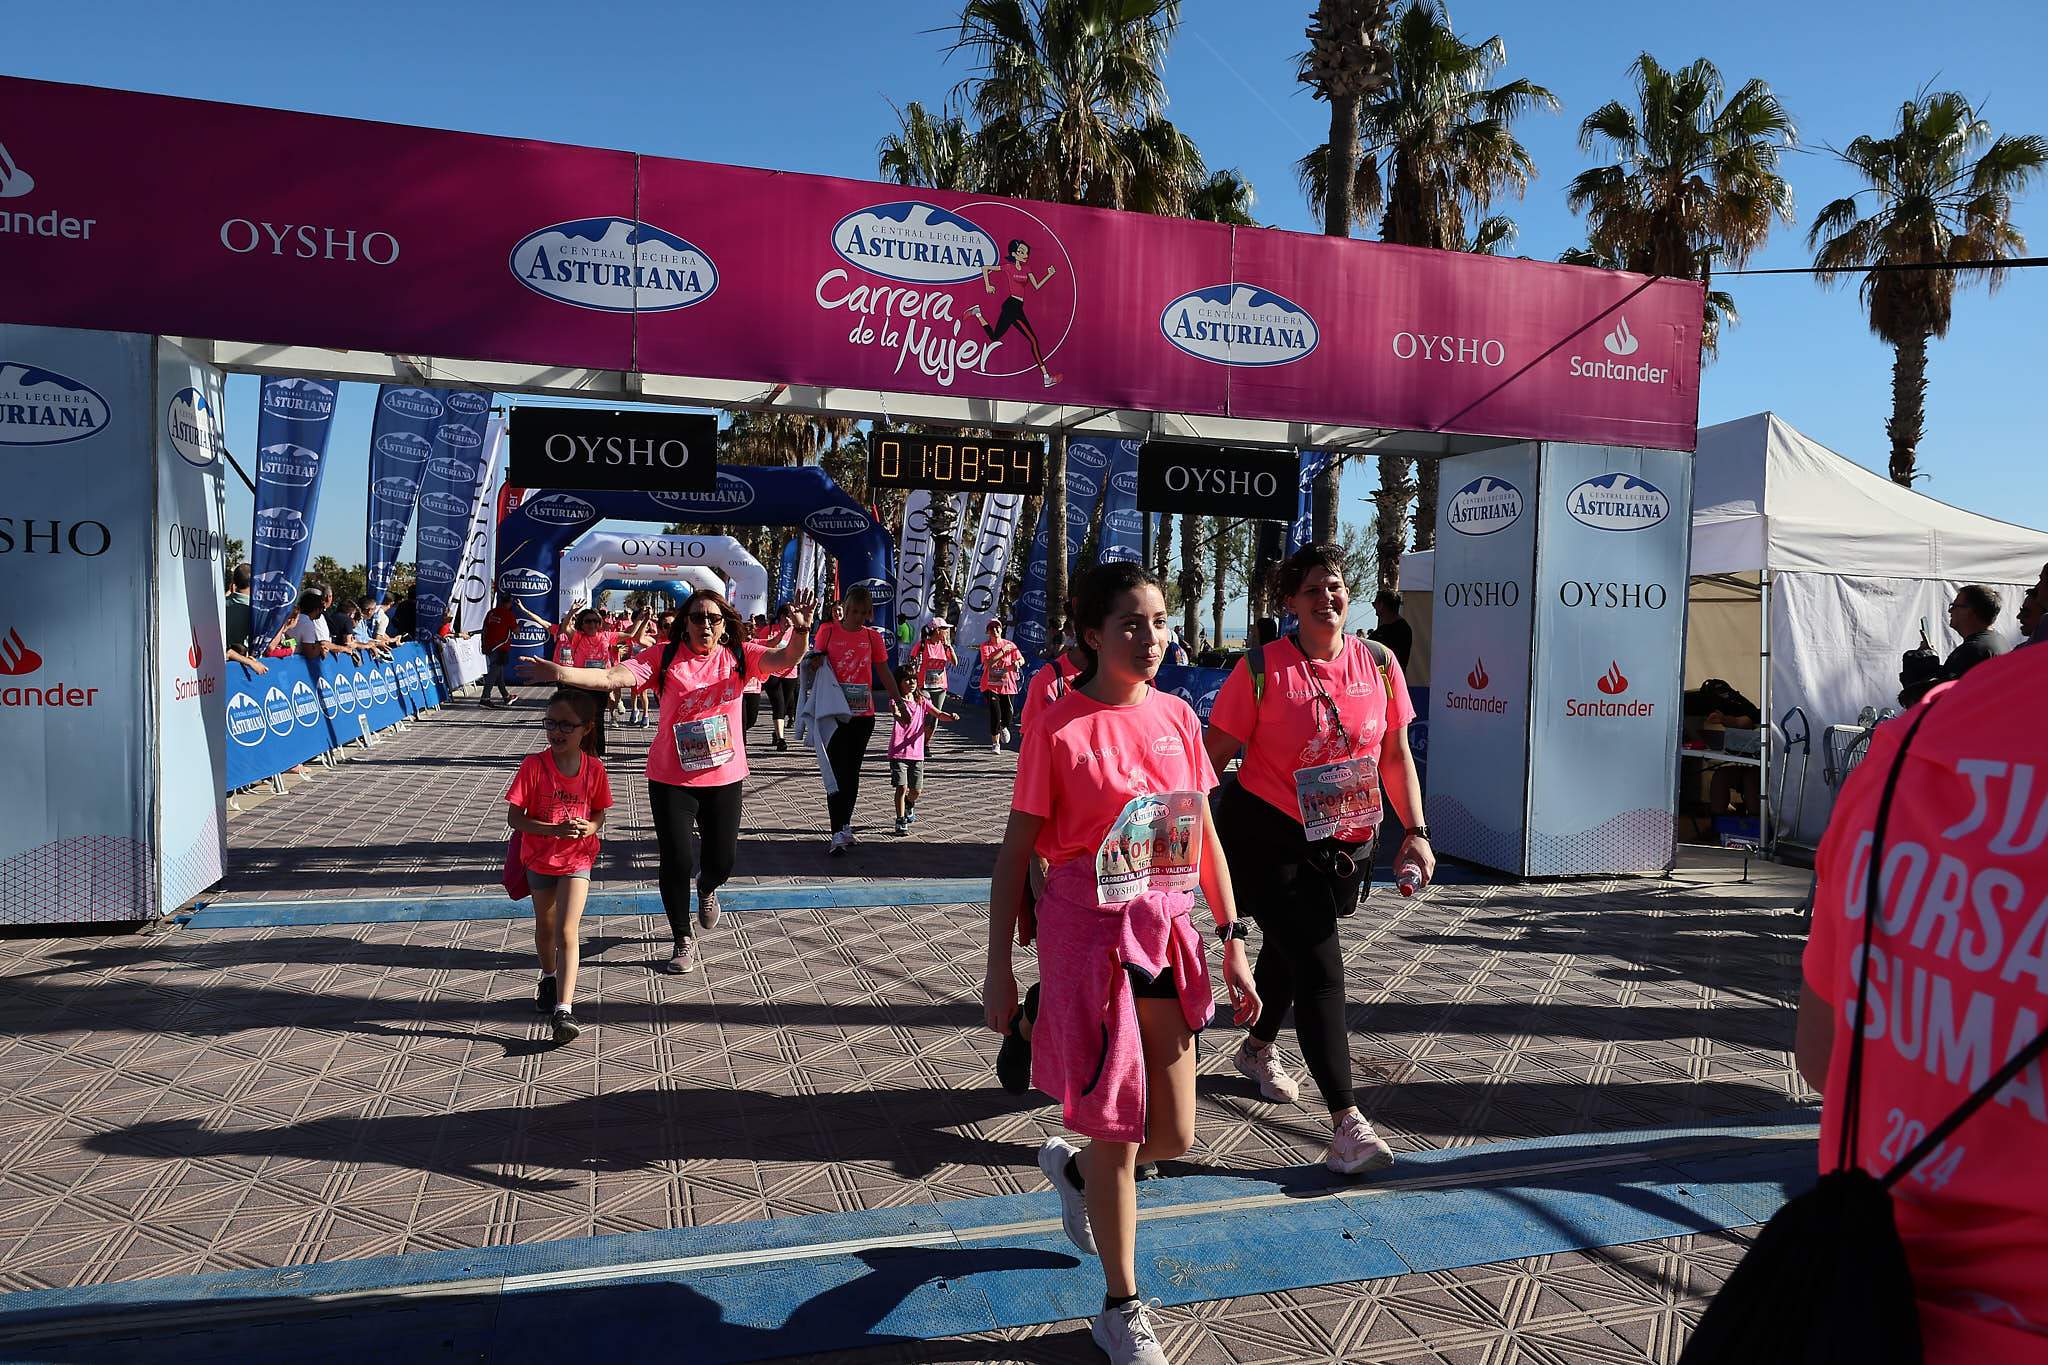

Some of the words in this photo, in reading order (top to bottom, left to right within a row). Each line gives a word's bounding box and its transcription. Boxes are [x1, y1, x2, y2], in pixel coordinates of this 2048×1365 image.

[220, 218, 400, 265] OYSHO
[845, 224, 985, 268] ASTURIANA
[871, 225, 925, 239] CENTRAL
[929, 233, 982, 245] LECHERA
[526, 245, 703, 293] ASTURIANA
[559, 245, 625, 260] CENTRAL
[632, 251, 697, 266] LECHERA
[815, 268, 954, 322] Carrera
[1173, 308, 1307, 349] ASTURIANA
[1198, 308, 1248, 320] CENTRAL
[1252, 313, 1303, 326] LECHERA
[849, 316, 876, 345] de
[880, 316, 899, 348] la
[894, 318, 1004, 387] Mujer
[1392, 332, 1505, 367] OYSHO
[1569, 356, 1669, 384] Santander
[25, 392, 89, 404] LECHERA
[545, 433, 689, 468] OYSHO
[880, 441, 1031, 484] 01:08:54
[1164, 465, 1278, 497] OYSHO
[1573, 491, 1662, 519] ASTURIANA
[1589, 491, 1623, 500] CENTRAL
[1624, 493, 1660, 502] LECHERA
[530, 504, 591, 519] ASTURIANA
[810, 516, 866, 530] ASTURIANA
[1451, 500, 1517, 524] ASTURIANA
[168, 524, 220, 562] OYSHO
[622, 538, 706, 559] OYSHO
[899, 509, 931, 621] OYSHO
[501, 578, 549, 591] ASTURIANA
[1444, 580, 1520, 608] OYSHO
[1559, 580, 1667, 610] OYSHO
[0, 683, 99, 707] ander
[175, 673, 216, 701] Santander
[1446, 692, 1508, 714] Santander
[1566, 699, 1655, 717] Santander
[1077, 745, 1120, 764] OYSHO
[1101, 873, 1128, 884] CARRERA
[1165, 866, 1193, 874] VALENCIA
